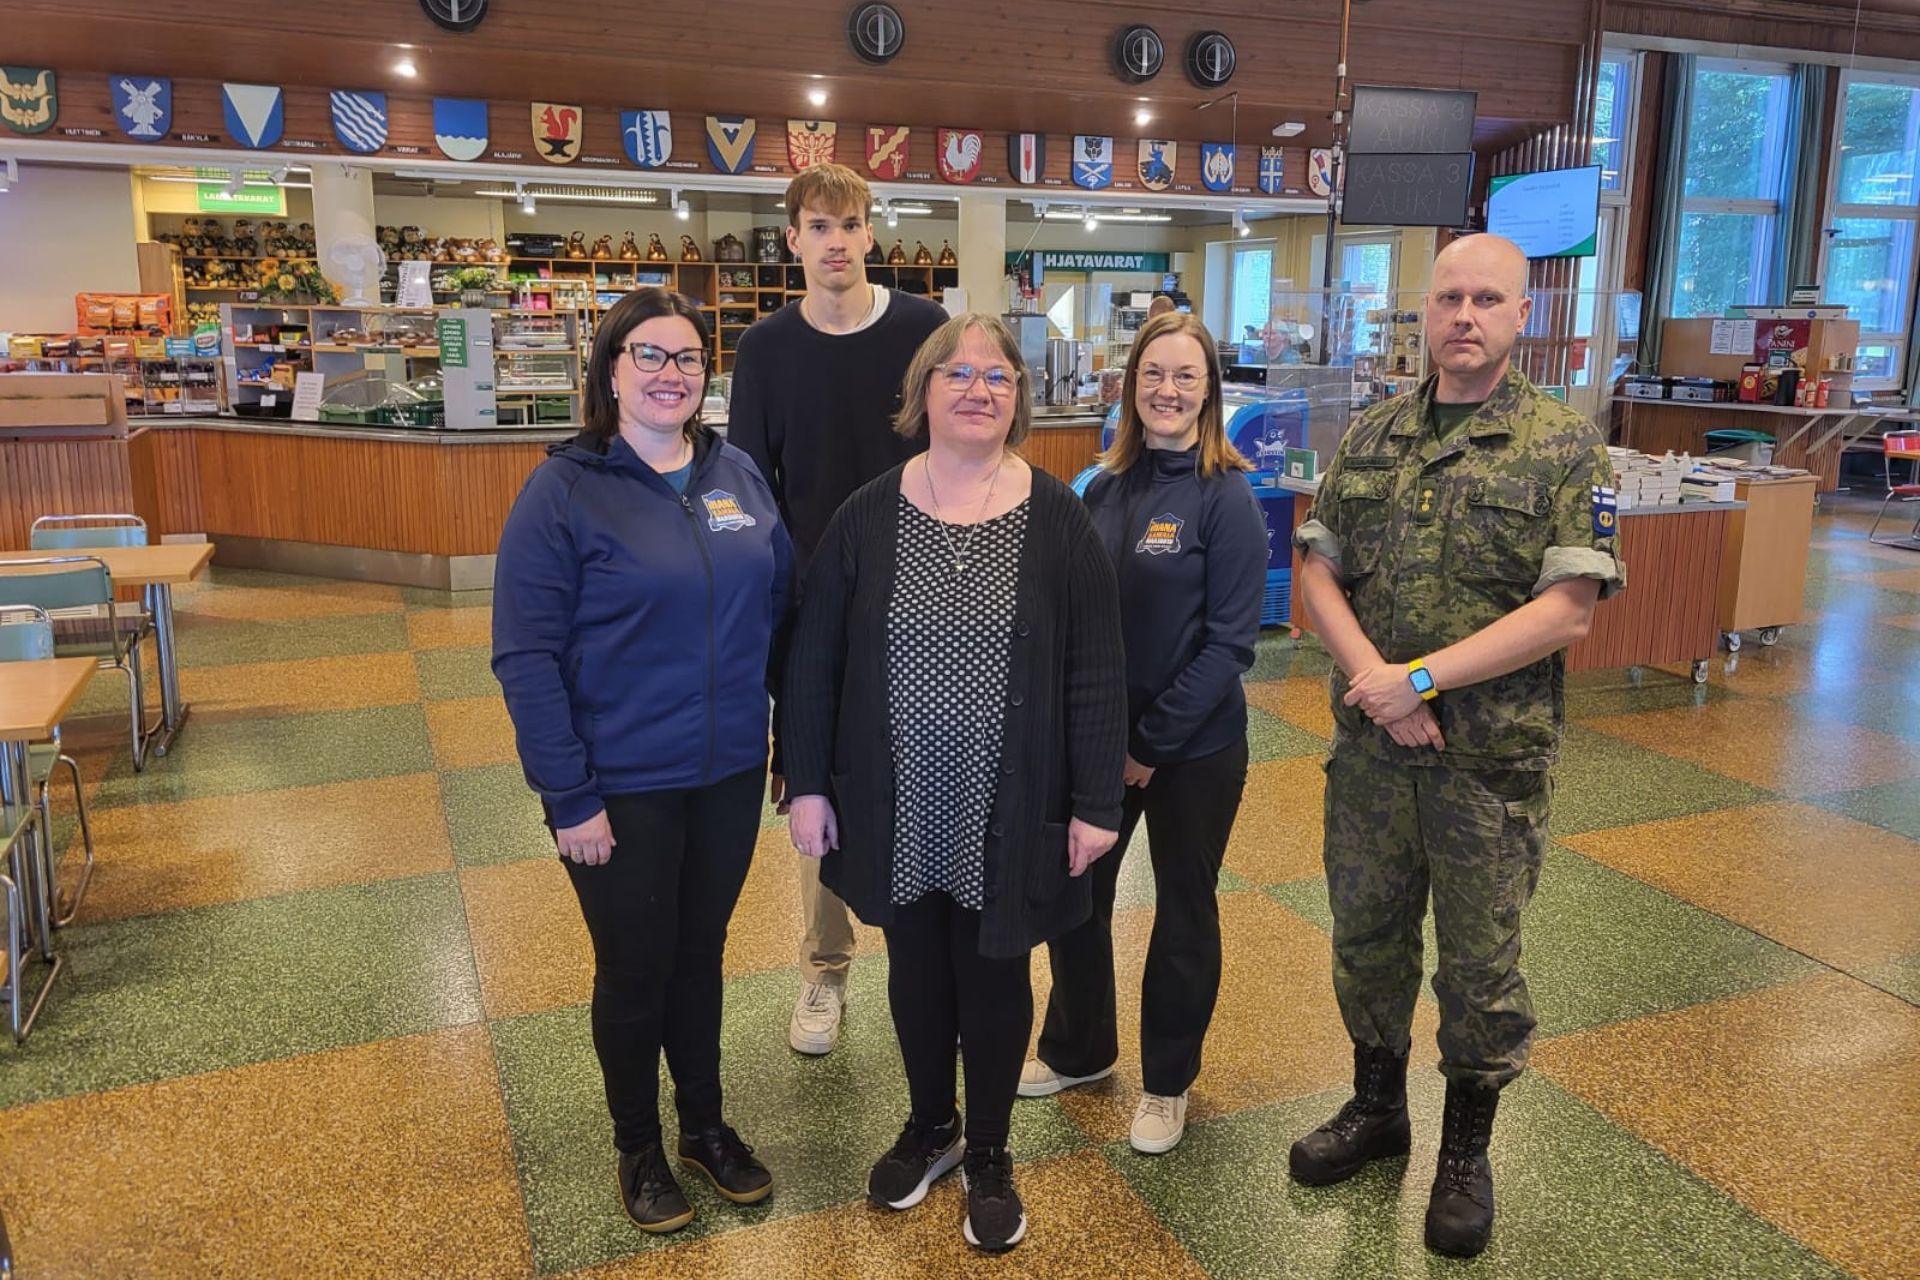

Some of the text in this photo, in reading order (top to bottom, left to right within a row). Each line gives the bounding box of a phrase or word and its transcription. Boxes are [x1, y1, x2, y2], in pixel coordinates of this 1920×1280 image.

[1361, 97, 1440, 119] KASSA
[1371, 123, 1448, 152] AUKI
[1354, 158, 1461, 184] KASSA 3
[1364, 187, 1443, 217] AUKI
[1026, 253, 1144, 269] HJATAVARAT
